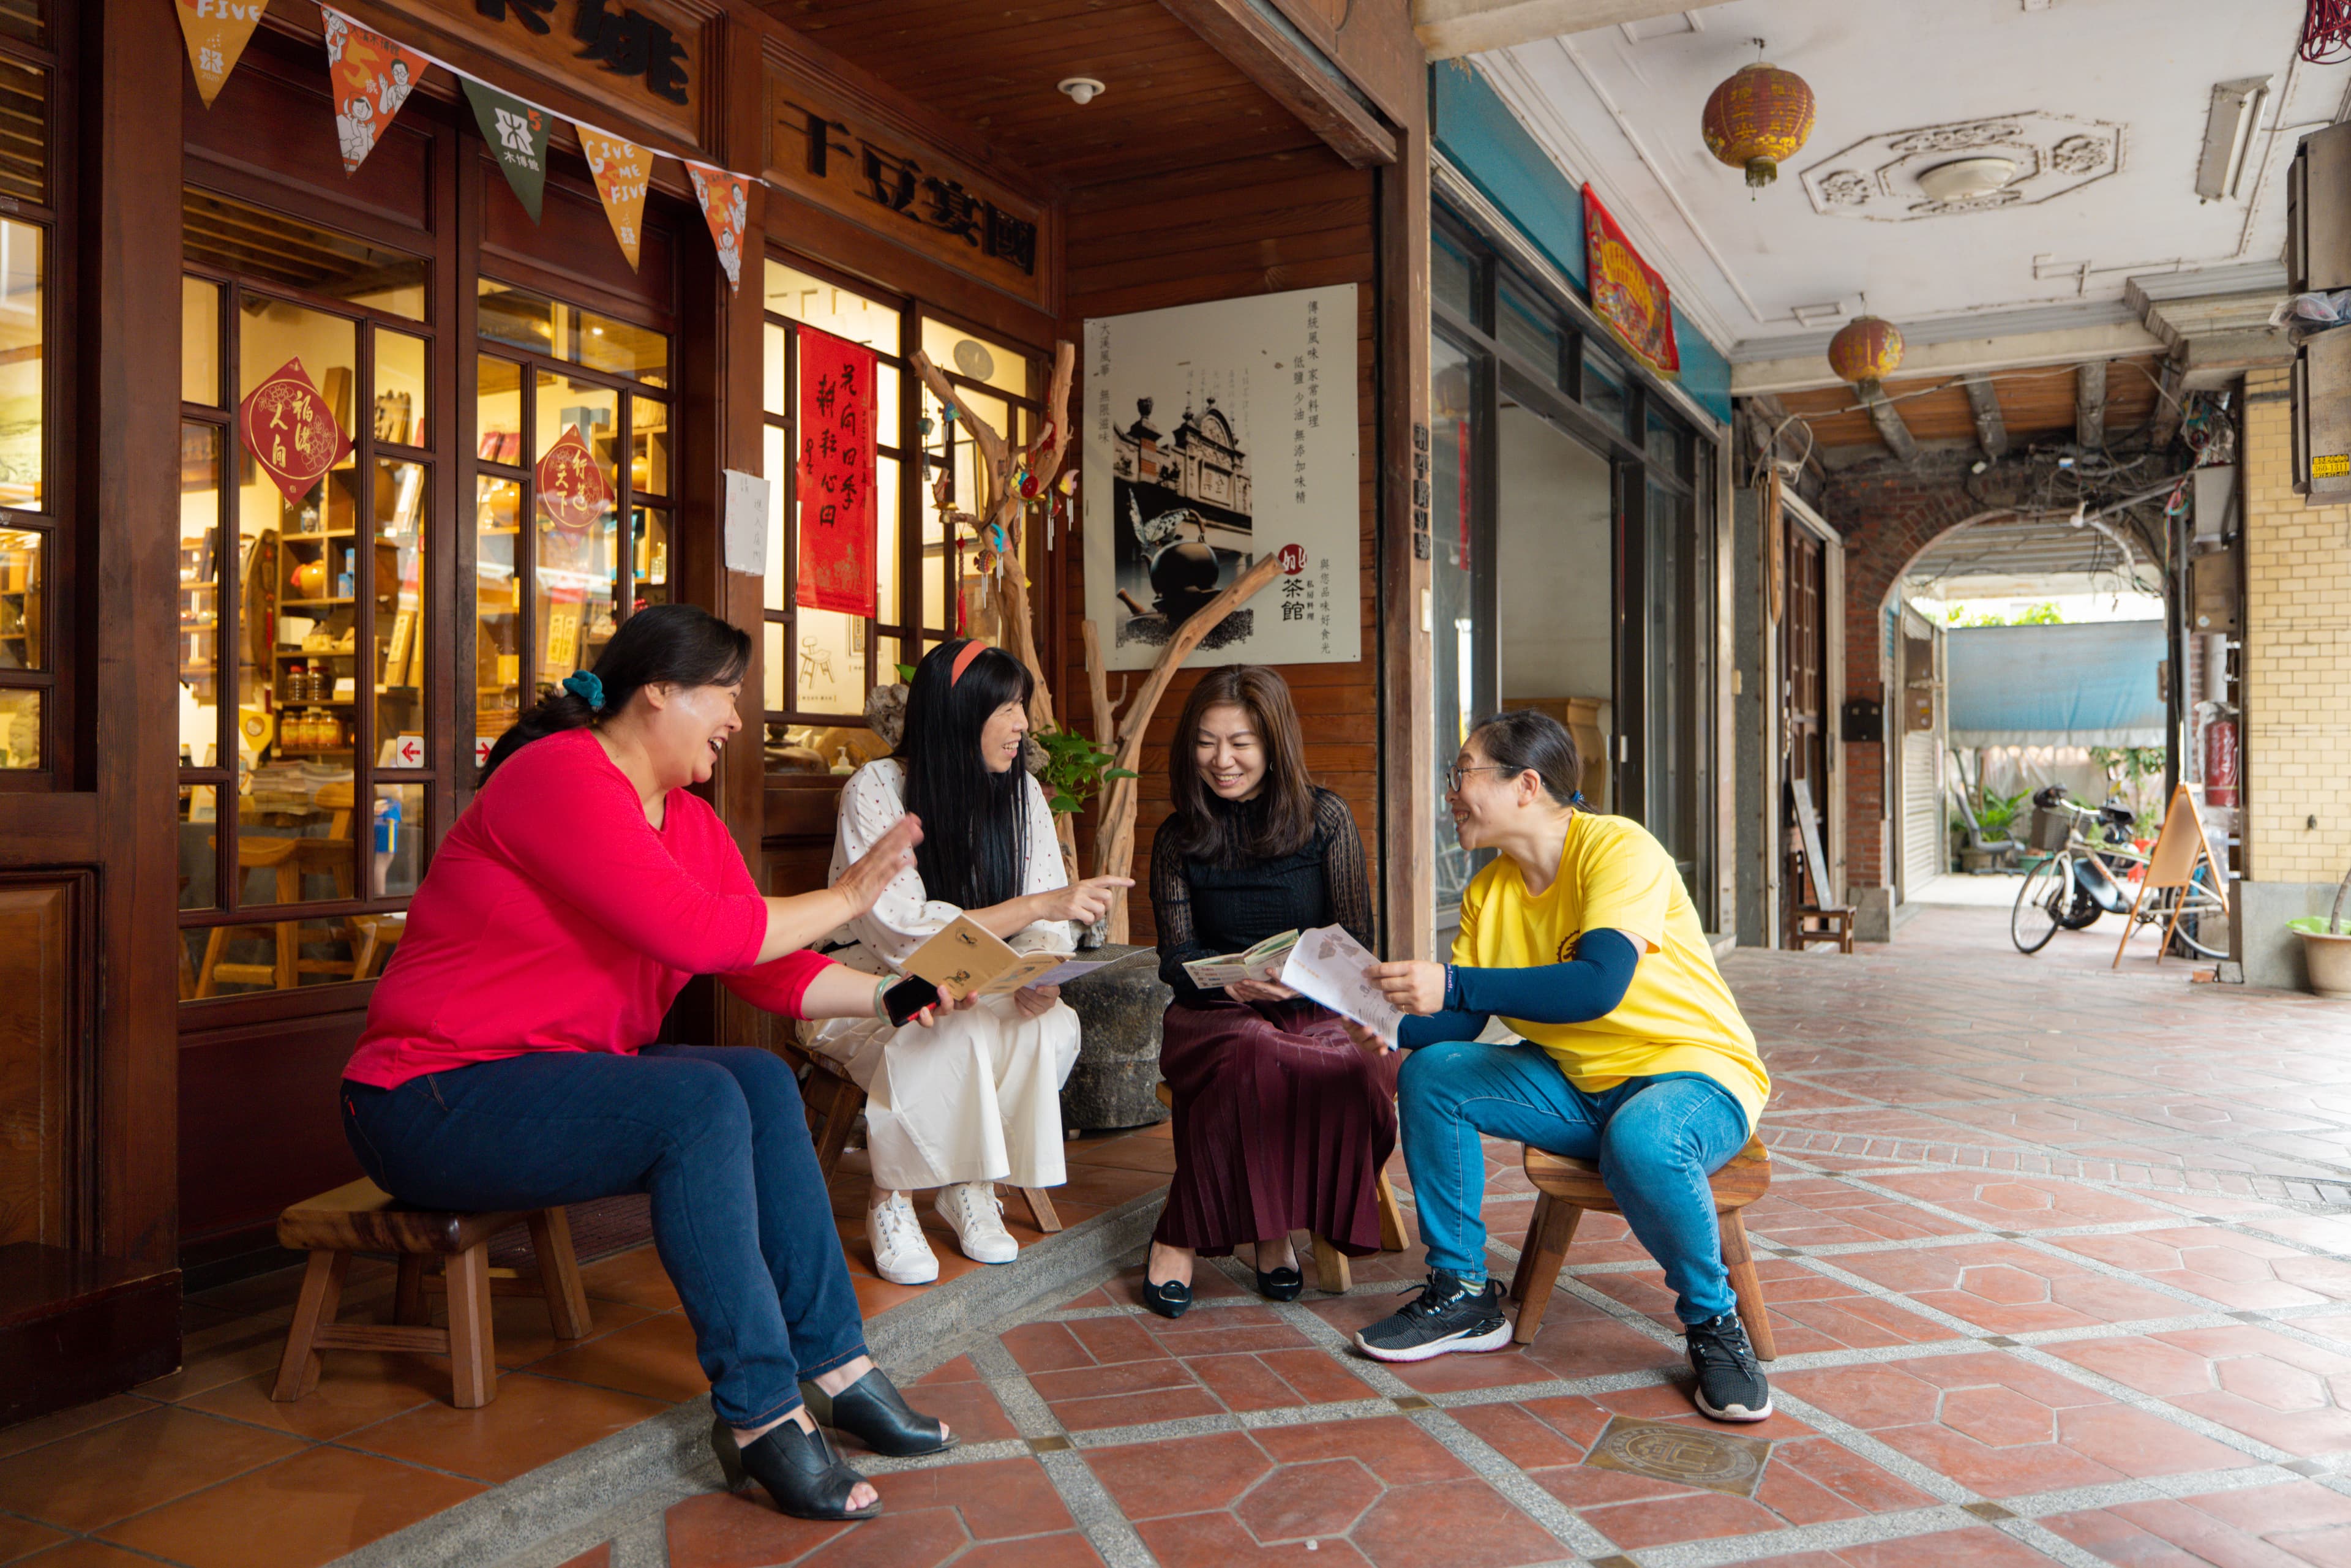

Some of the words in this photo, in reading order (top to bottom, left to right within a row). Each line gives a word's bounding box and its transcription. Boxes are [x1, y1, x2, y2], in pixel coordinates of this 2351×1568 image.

[197, 0, 261, 23] FIVE
[503, 151, 540, 172] 木博館
[585, 140, 635, 174] GIVE
[618, 163, 642, 179] ME
[610, 182, 647, 205] FIVE
[1307, 301, 1319, 360] 傳統風味
[1293, 392, 1305, 421] 少油
[1308, 368, 1319, 428] 家常料理
[269, 402, 288, 468] 人間
[1293, 429, 1307, 505] 無添加味精
[1281, 578, 1305, 621] 茶館
[1319, 558, 1331, 655] 與您品味好食光
